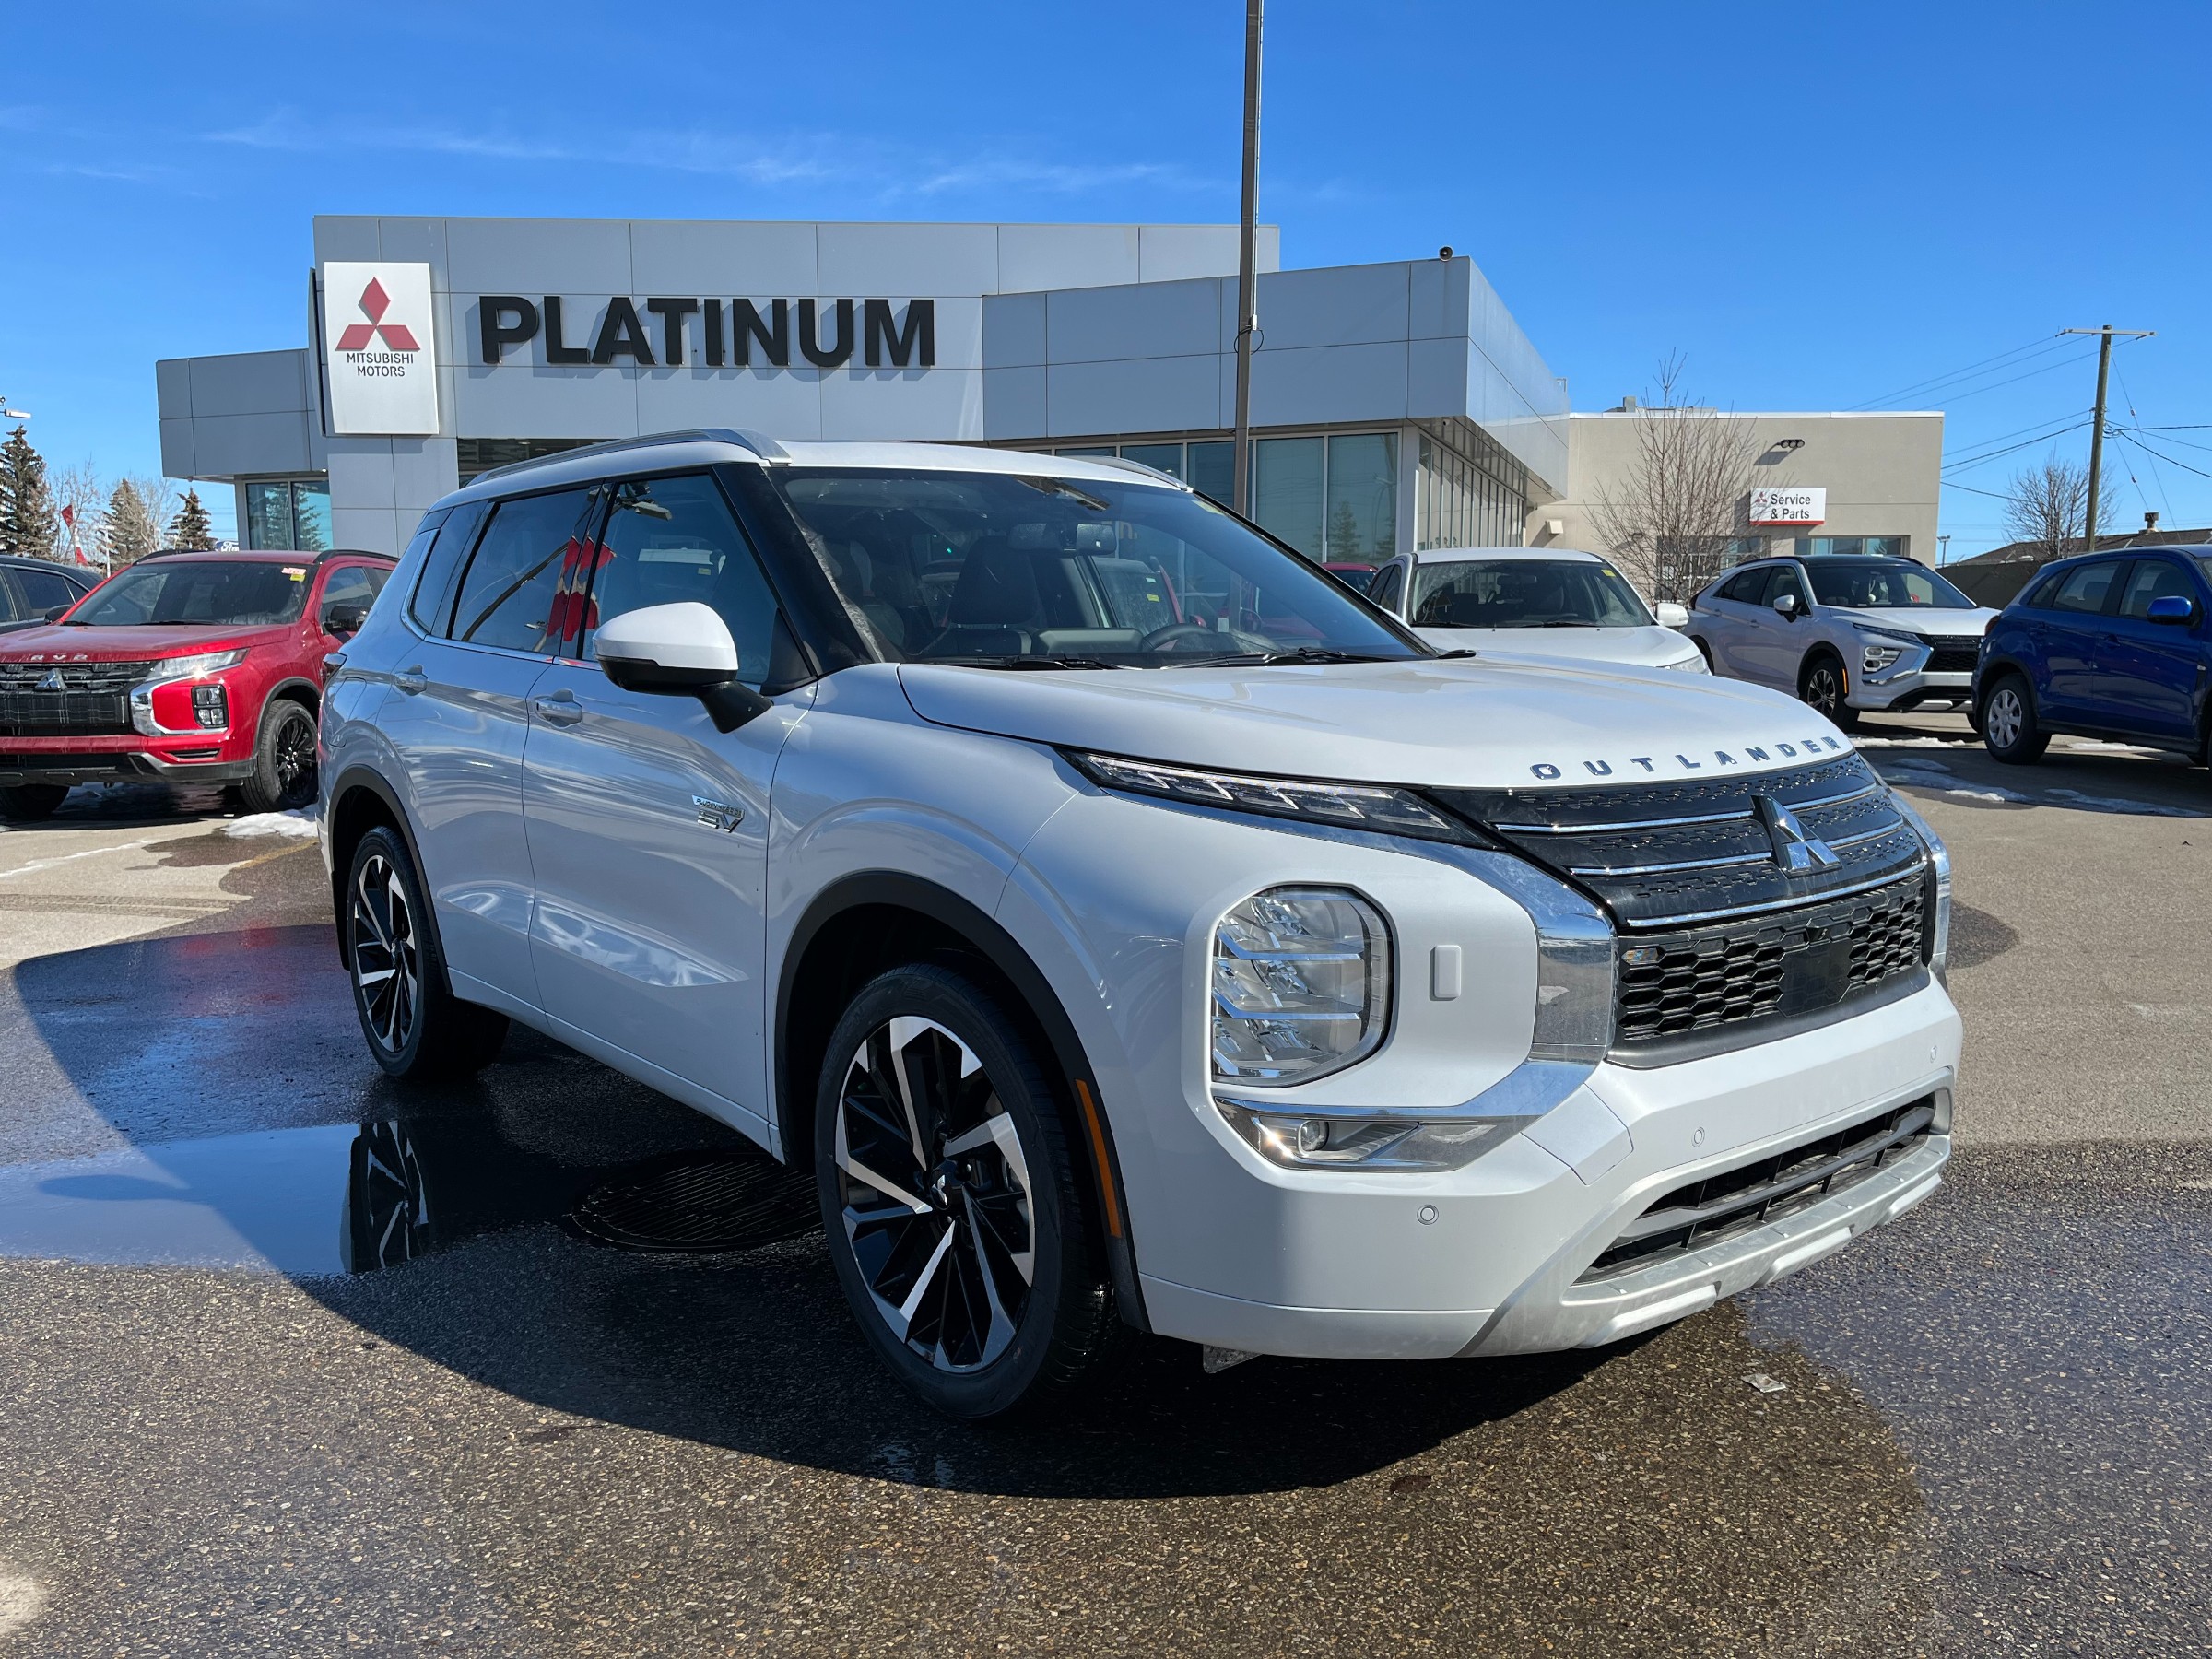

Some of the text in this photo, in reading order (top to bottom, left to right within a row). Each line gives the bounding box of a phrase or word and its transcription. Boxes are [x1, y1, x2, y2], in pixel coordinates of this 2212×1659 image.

[478, 295, 935, 368] PLATINUM
[347, 352, 414, 364] MITSUBISHI
[357, 365, 406, 377] MOTORS
[1771, 493, 1811, 505] Service
[1771, 508, 1810, 519] & Parts
[1529, 736, 1841, 780] OUTLANDER
